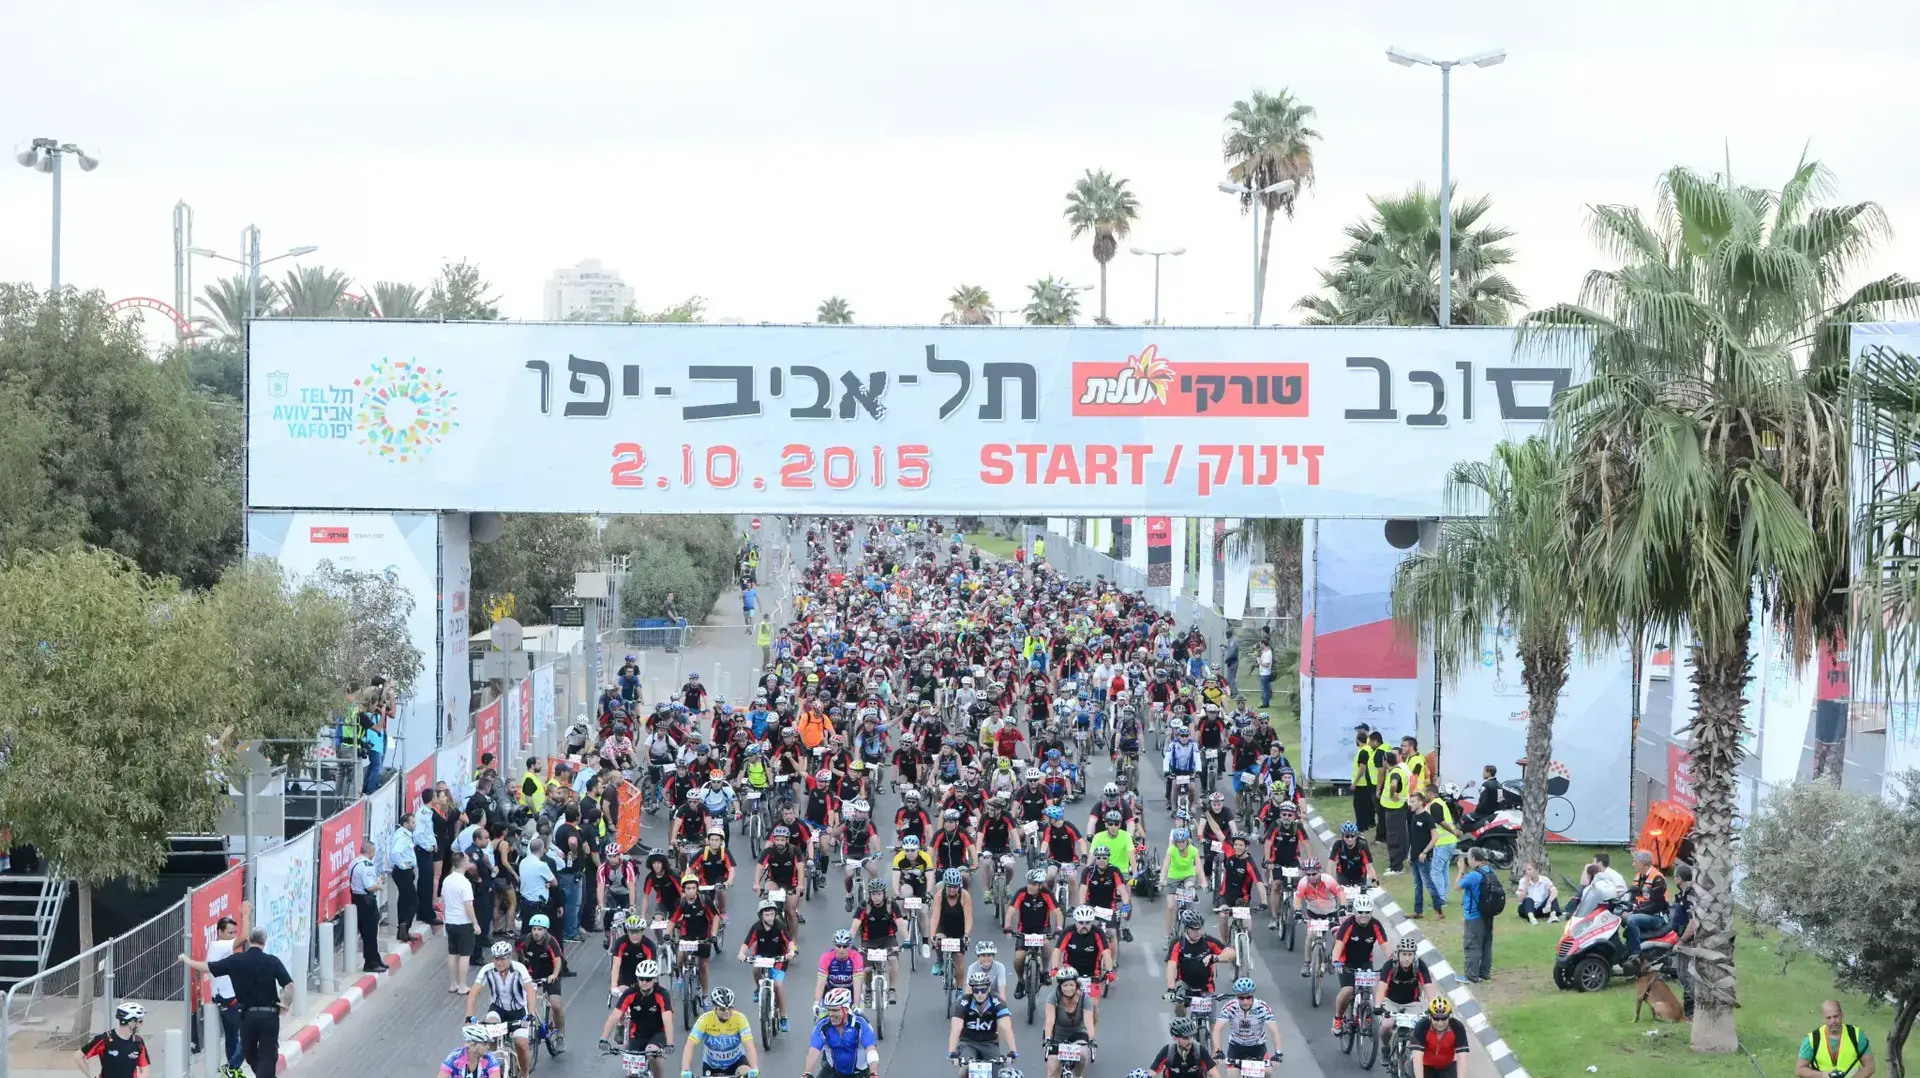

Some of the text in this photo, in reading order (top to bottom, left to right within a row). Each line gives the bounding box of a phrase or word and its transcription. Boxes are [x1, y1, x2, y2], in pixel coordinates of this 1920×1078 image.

[300, 384, 354, 404] TEL תל
[1080, 368, 1149, 405] עלית
[1180, 375, 1302, 413] טורקי
[1345, 356, 1572, 426] סובב
[273, 405, 353, 422] AVIV אביב
[288, 423, 353, 438] YAFO יפו
[610, 443, 933, 490] 2.10.2015
[980, 444, 1153, 485] START
[1198, 445, 1325, 496] זינוק
[966, 1018, 993, 1031] sky
